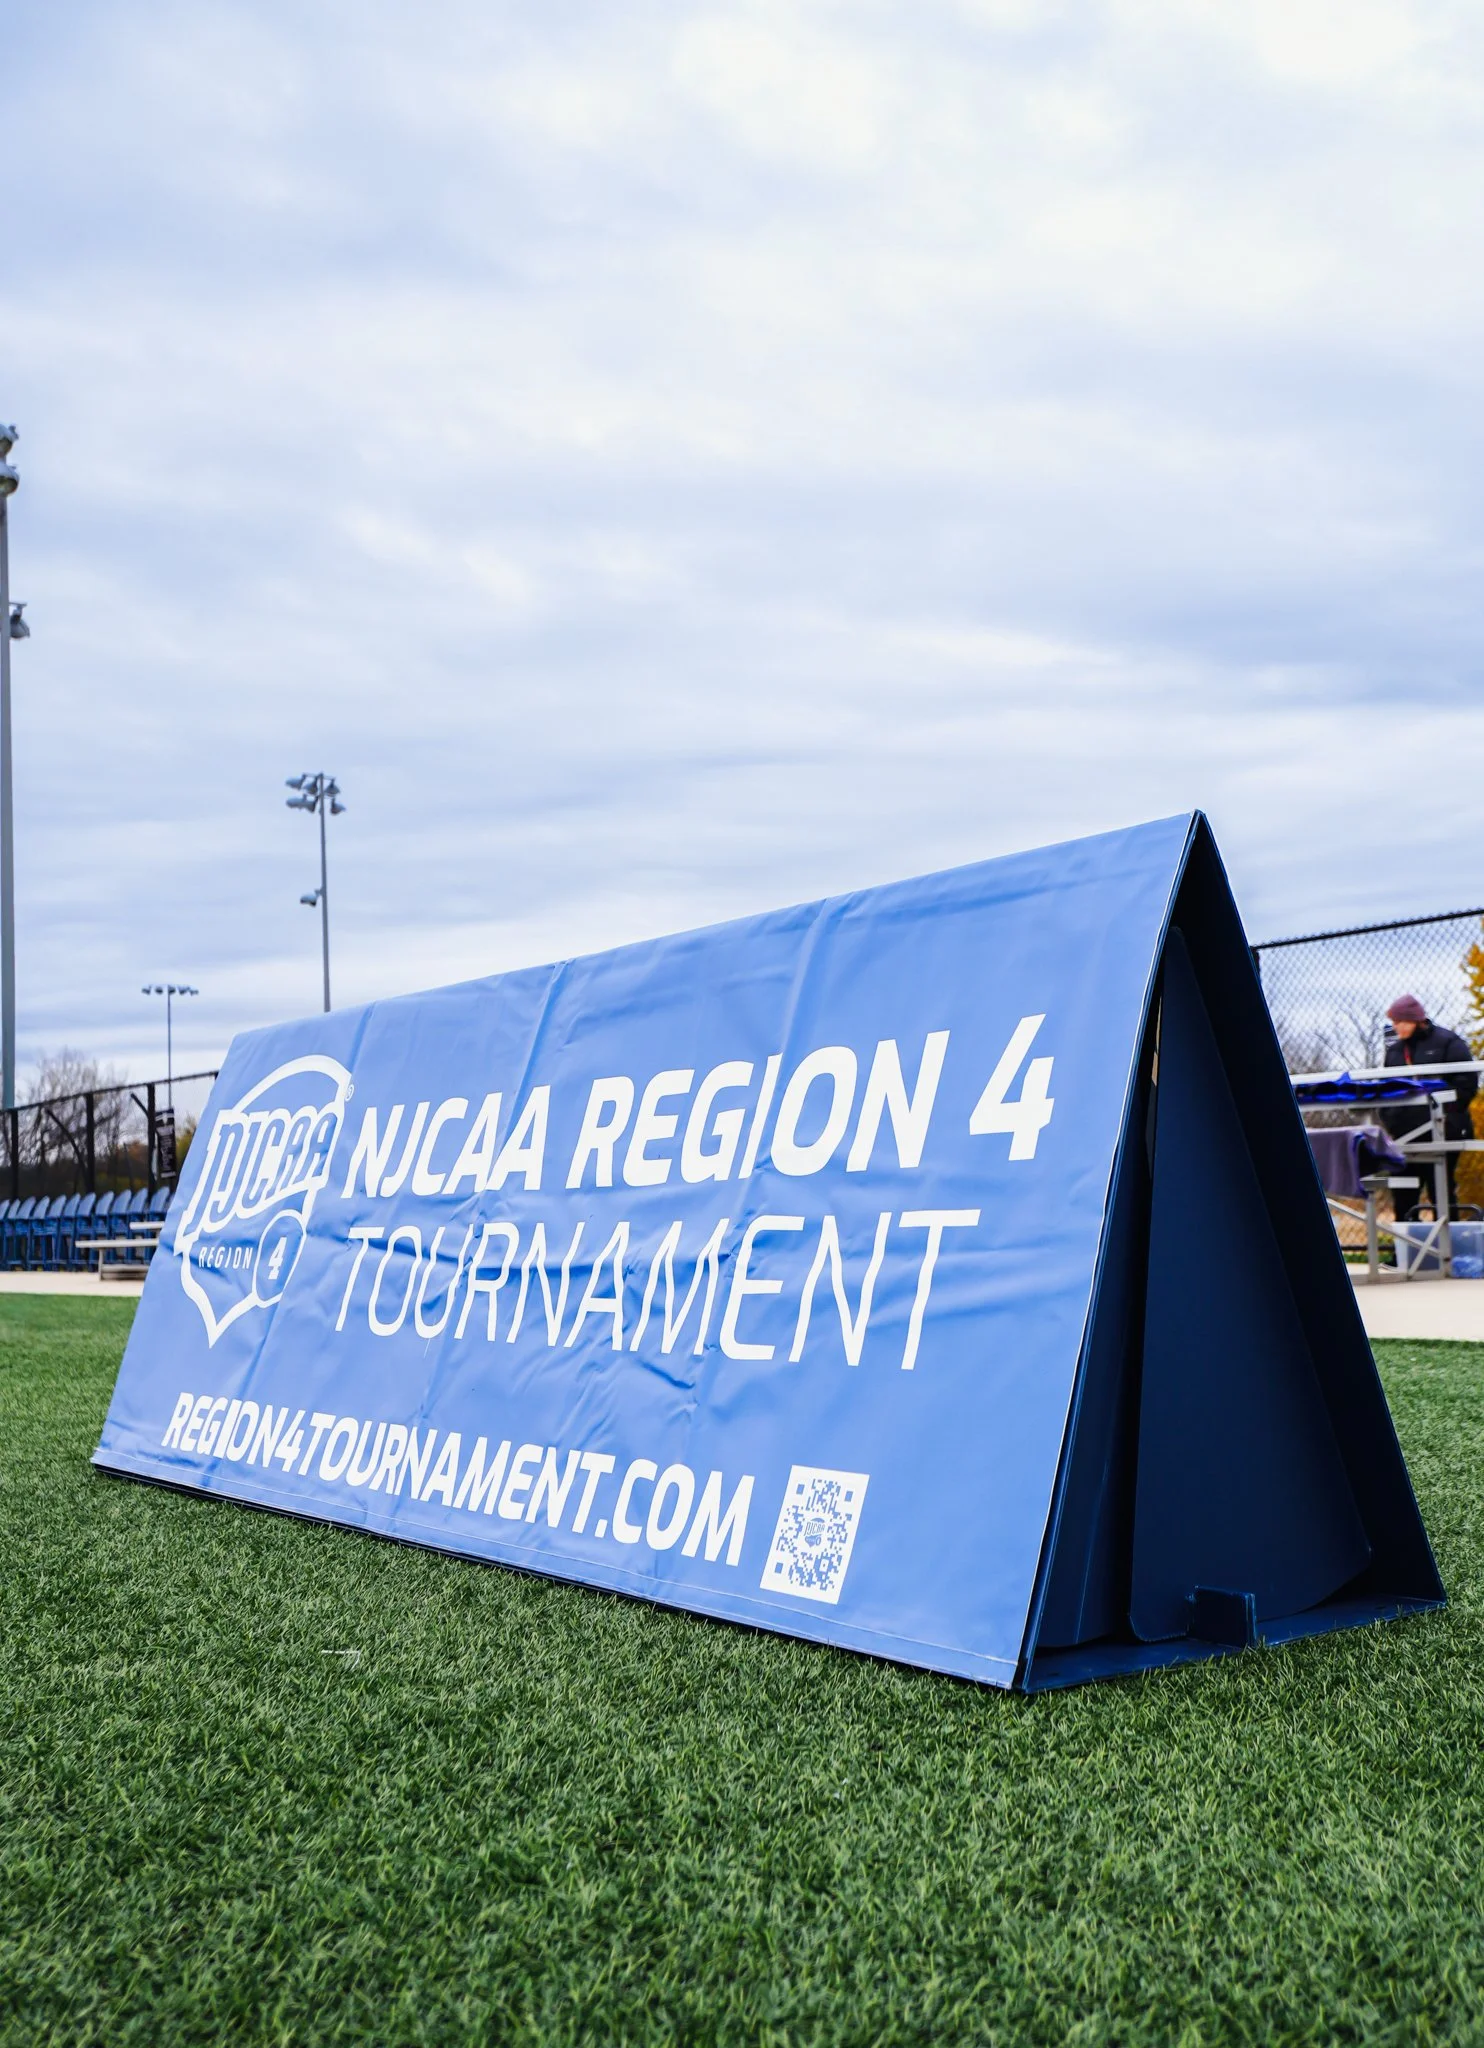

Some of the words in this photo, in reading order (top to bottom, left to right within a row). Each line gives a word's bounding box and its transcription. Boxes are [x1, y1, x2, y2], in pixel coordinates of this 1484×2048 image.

[180, 1108, 341, 1239] NJCAA
[340, 1084, 550, 1200] NJCAA
[565, 1031, 951, 1189] REGION
[969, 1014, 1055, 1161] 4
[198, 1246, 253, 1269] REGION
[267, 1236, 287, 1280] 4
[336, 1209, 980, 1370] TOURNAMENT
[161, 1392, 755, 1567] REGION4TOURNAMENT.COM
